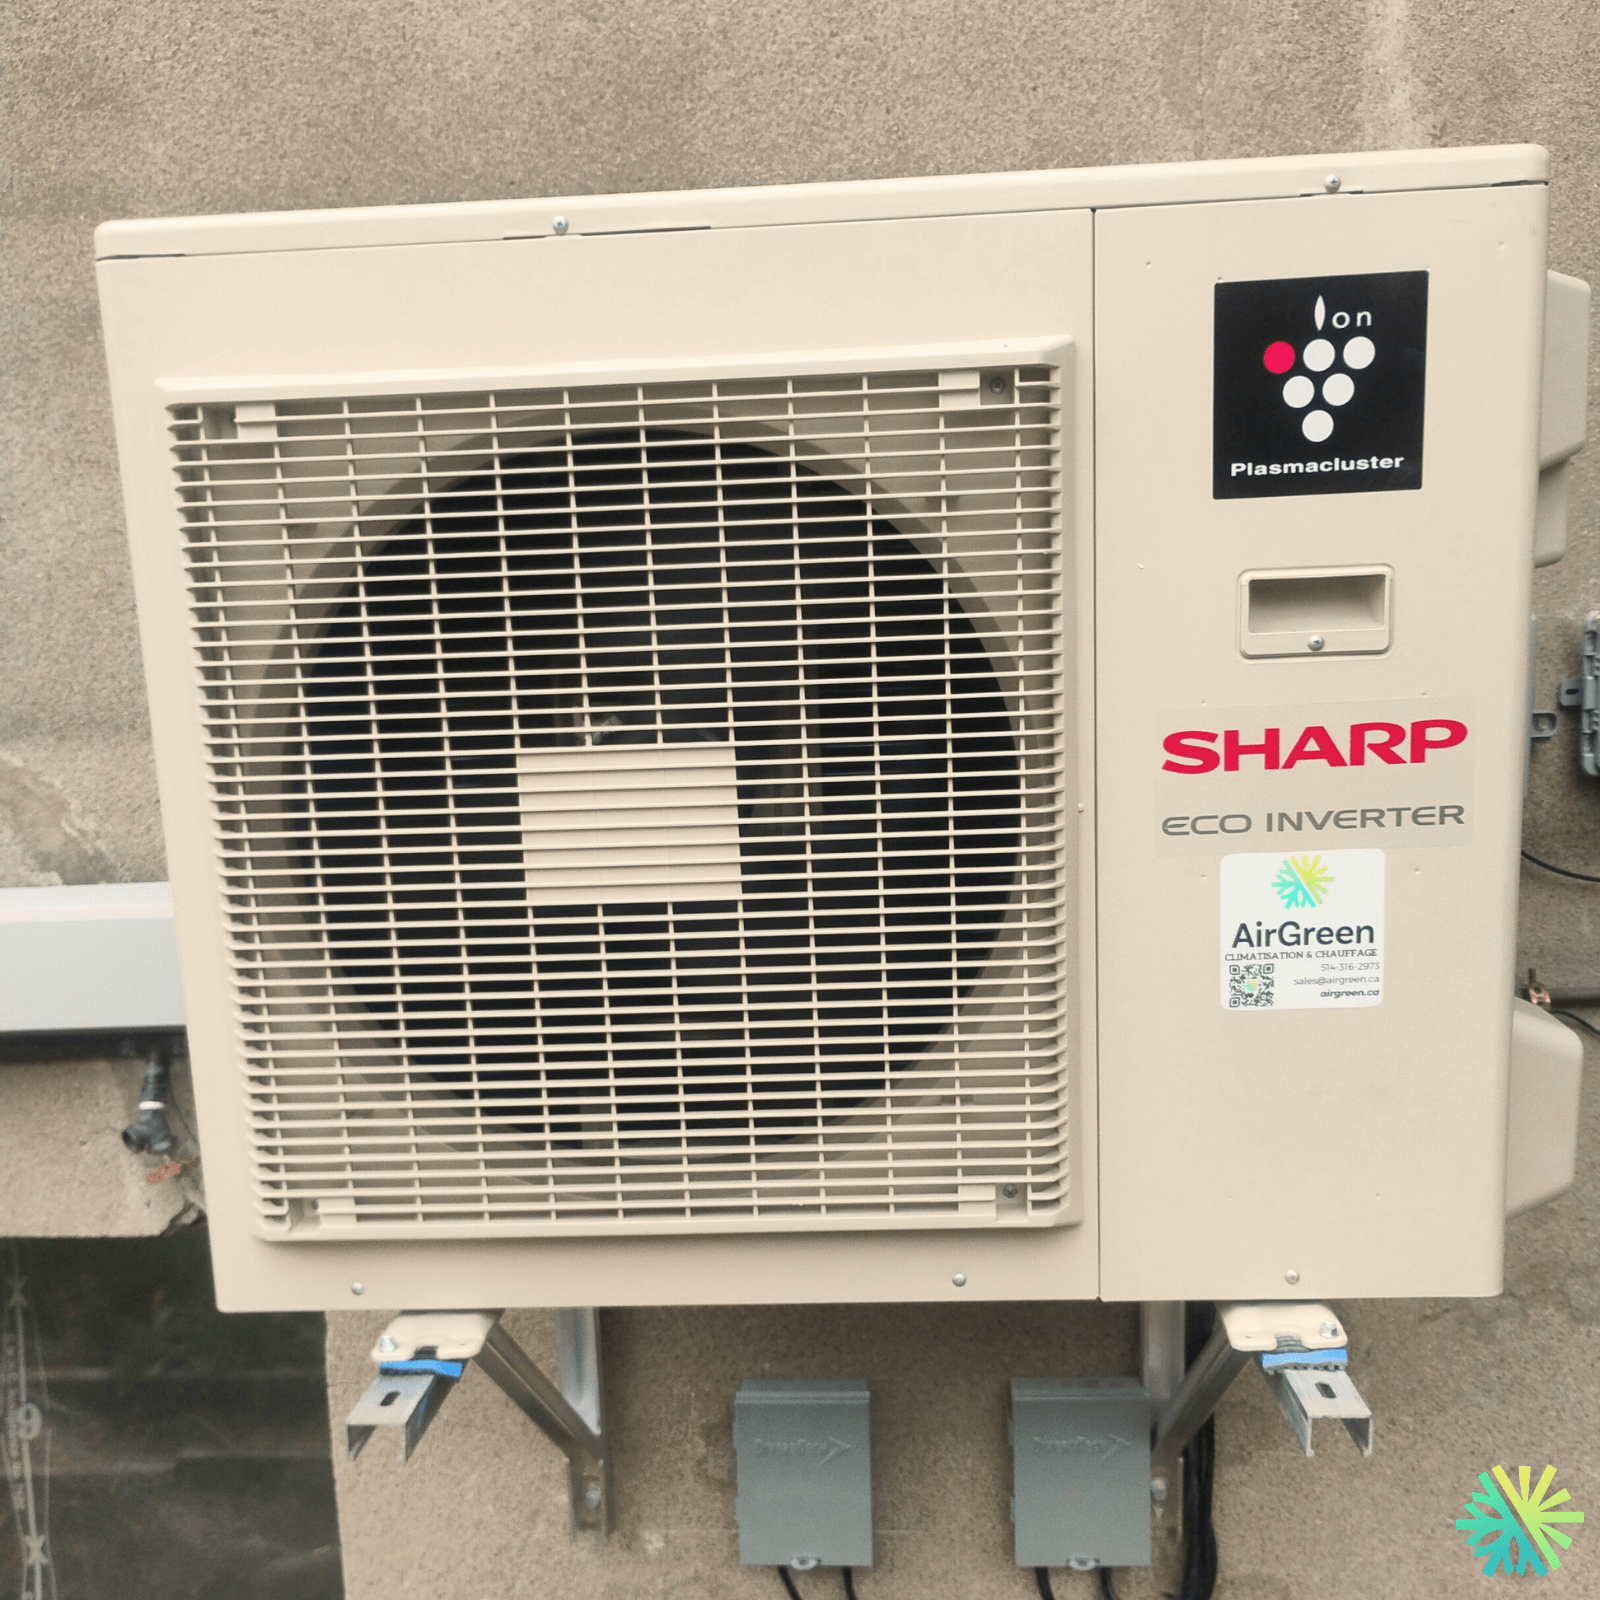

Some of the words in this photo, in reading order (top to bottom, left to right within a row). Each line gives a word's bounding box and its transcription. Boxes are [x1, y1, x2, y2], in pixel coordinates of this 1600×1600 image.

[1314, 295, 1372, 331] Ion
[1230, 455, 1405, 477] Plasmacluster
[1161, 718, 1468, 775] SHARP
[1161, 814, 1252, 836] ECO
[1266, 804, 1465, 832] INVERTER
[1231, 920, 1375, 949] AirGreen
[1224, 951, 1304, 962] CLIMATISATION
[1306, 951, 1313, 959] &
[1315, 948, 1378, 959] CHAUFFAGE
[1320, 962, 1380, 972] 514-316-2973
[1293, 975, 1380, 986] sales@airgreen.ca
[1320, 989, 1380, 999] airgreen.ca
